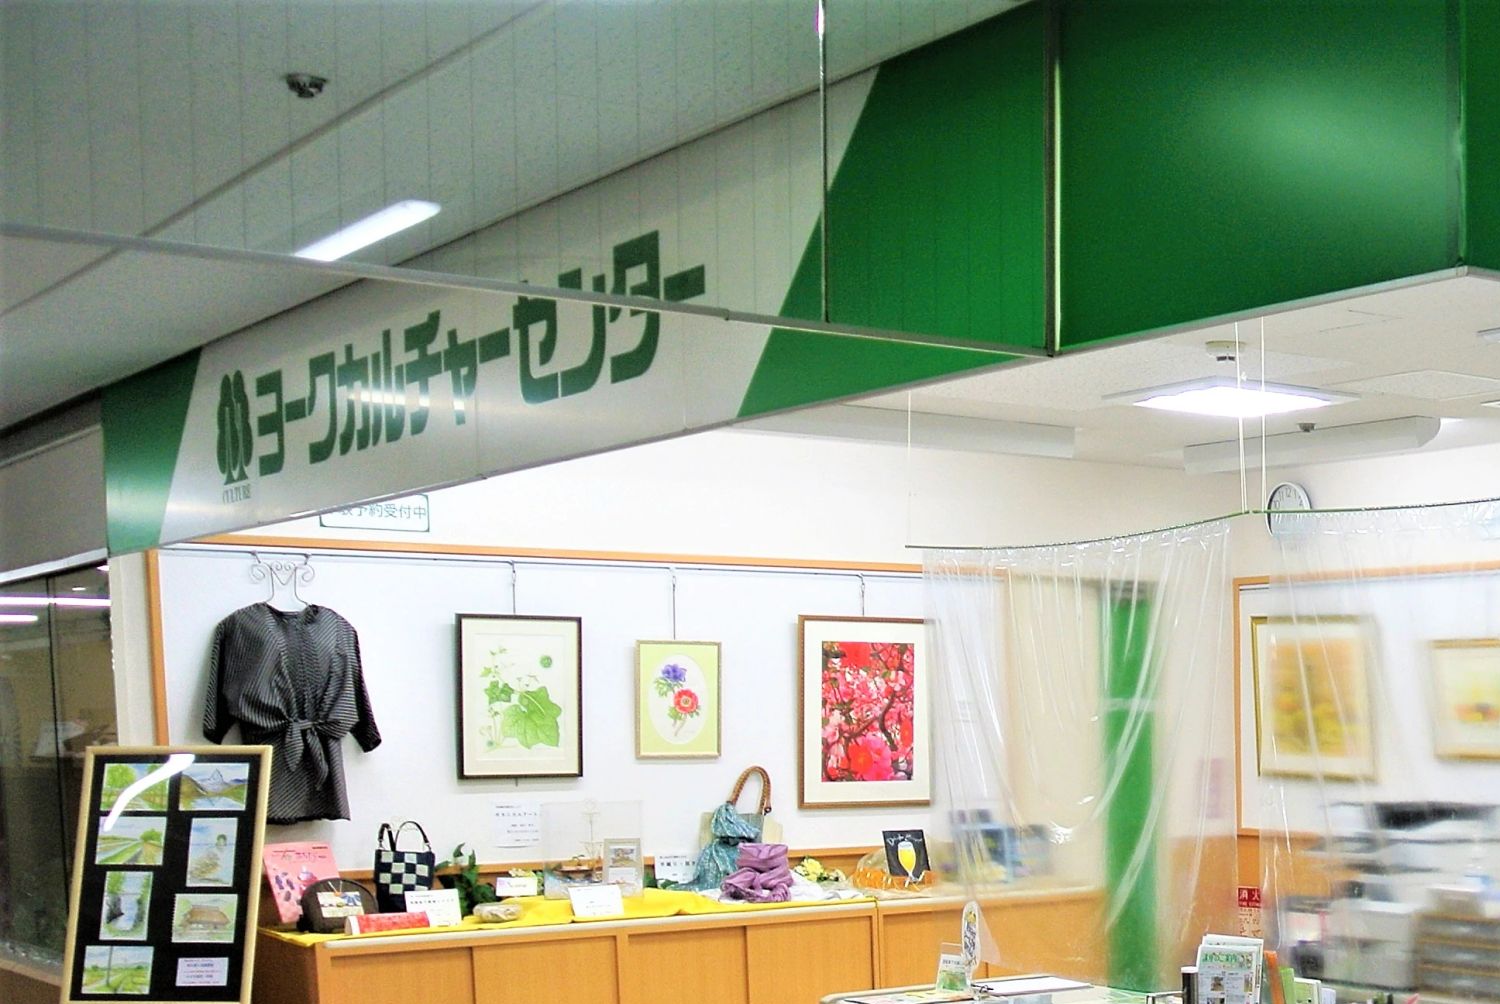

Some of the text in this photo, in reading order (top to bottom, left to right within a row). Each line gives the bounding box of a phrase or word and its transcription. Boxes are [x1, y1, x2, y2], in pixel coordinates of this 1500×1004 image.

[256, 229, 705, 477] ヨークカルチャーセンター
[222, 482, 252, 505] CULTURE
